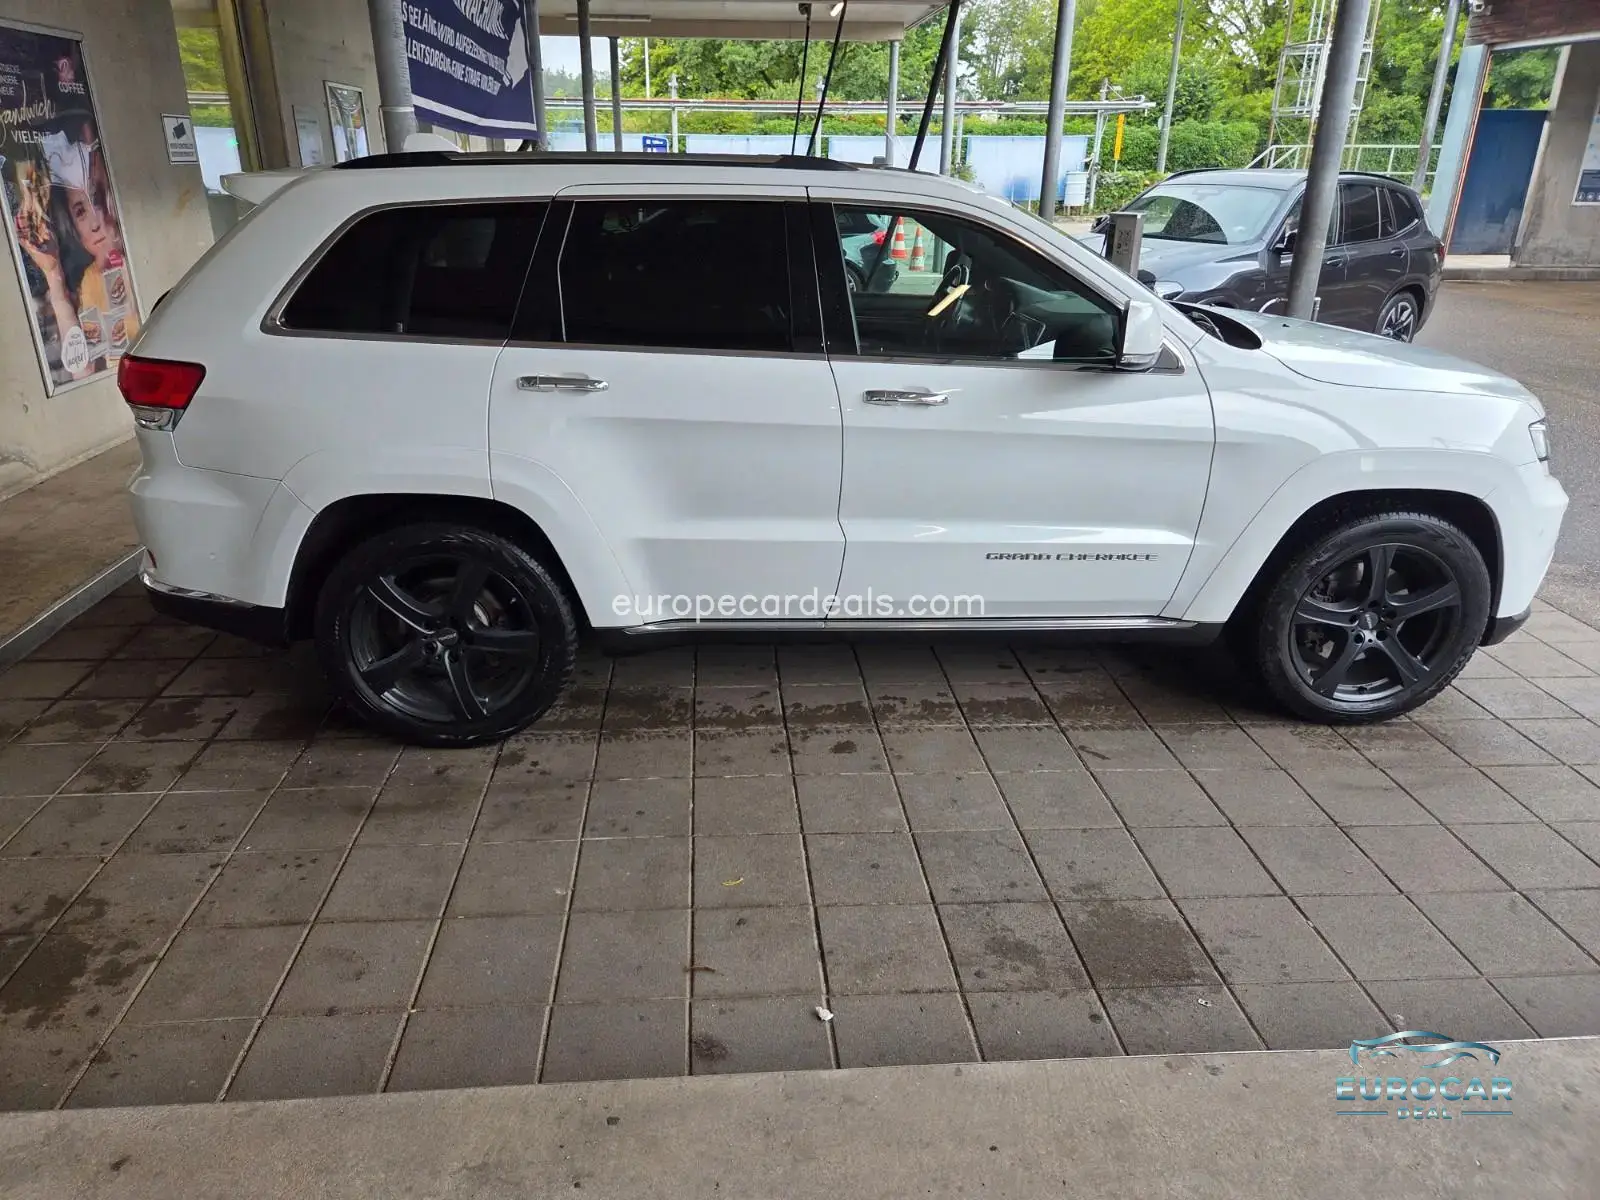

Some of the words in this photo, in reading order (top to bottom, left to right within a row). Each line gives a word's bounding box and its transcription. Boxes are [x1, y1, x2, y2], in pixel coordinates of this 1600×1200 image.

[58, 81, 85, 94] COFFEE
[985, 552, 1052, 561] GRAND
[1056, 552, 1159, 562] CHEROKEE
